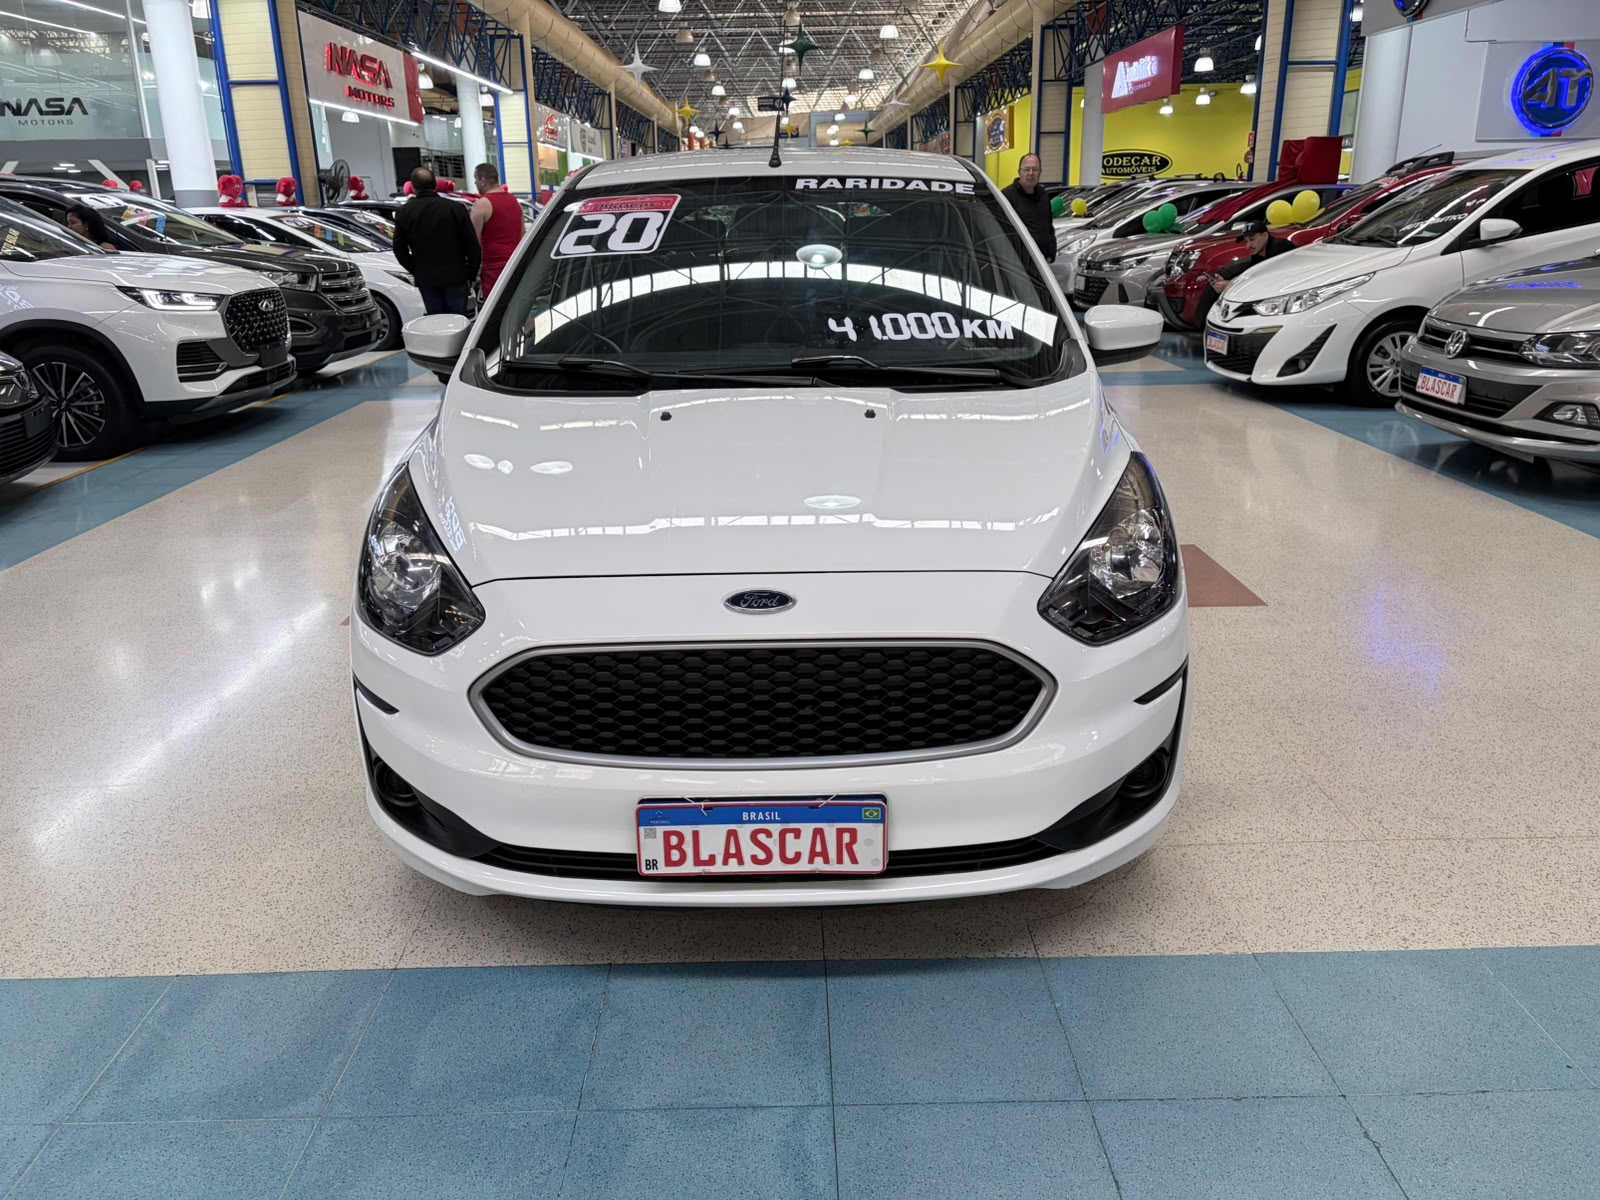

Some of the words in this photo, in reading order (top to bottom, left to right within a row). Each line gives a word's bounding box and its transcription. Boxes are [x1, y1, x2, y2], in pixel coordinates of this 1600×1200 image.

[325, 42, 393, 89] NASA
[0, 97, 88, 116] NASA
[345, 85, 395, 110] MOTORS
[795, 178, 976, 196] RARIDADE
[560, 211, 664, 254] 20
[1420, 375, 1457, 400] BLASCAR
[740, 592, 780, 607] Ford
[742, 811, 781, 821] BRASIL
[663, 827, 859, 868] BLASCAR
[645, 859, 659, 870] BR
